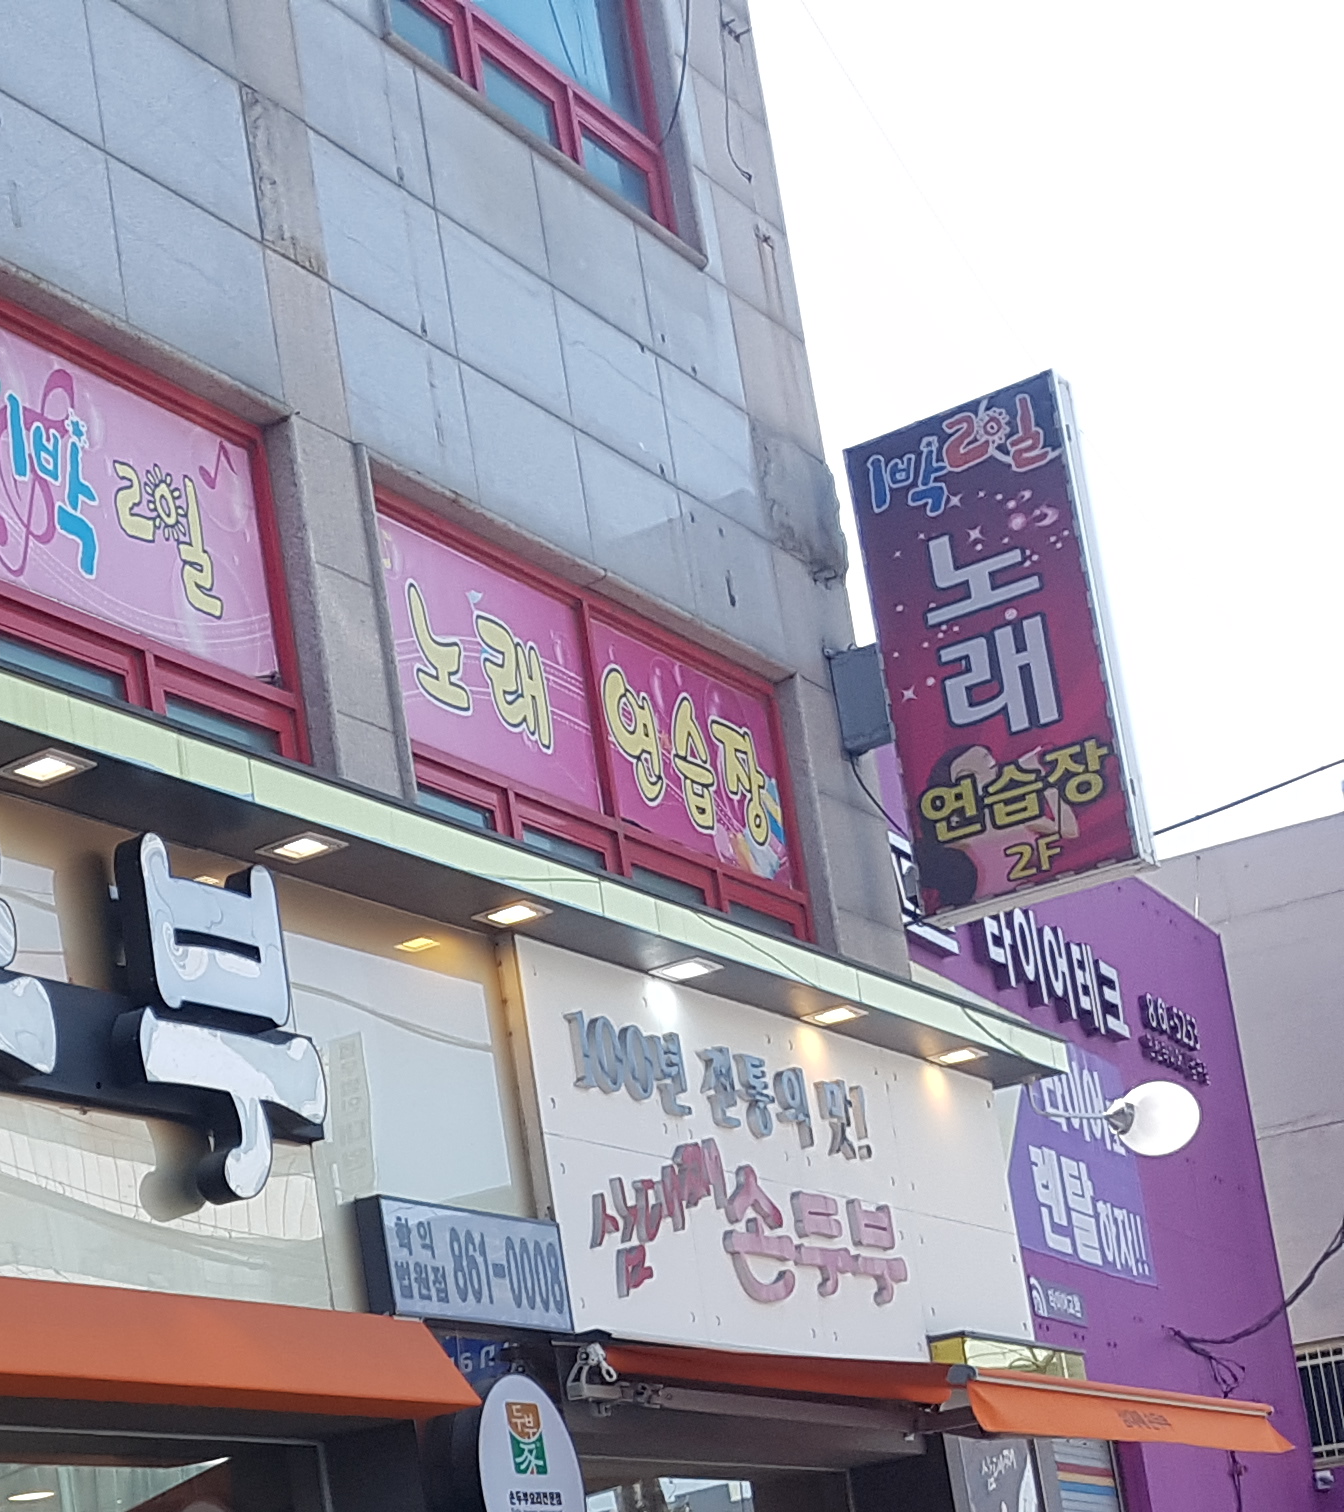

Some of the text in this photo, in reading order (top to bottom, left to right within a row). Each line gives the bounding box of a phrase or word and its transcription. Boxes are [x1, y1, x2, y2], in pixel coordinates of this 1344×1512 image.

[925, 532, 1063, 734] 노래
[404, 577, 771, 849] 노래 연습장
[920, 738, 1110, 844] 연습장
[1004, 832, 1062, 883] 2F
[982, 907, 1131, 1040] 타이어테크
[563, 1010, 692, 1117] 100년
[695, 1045, 815, 1150] 전통의
[394, 1260, 450, 1304] 법원점
[449, 1226, 564, 1314] 861-0008
[722, 1164, 908, 1306] 손두부
